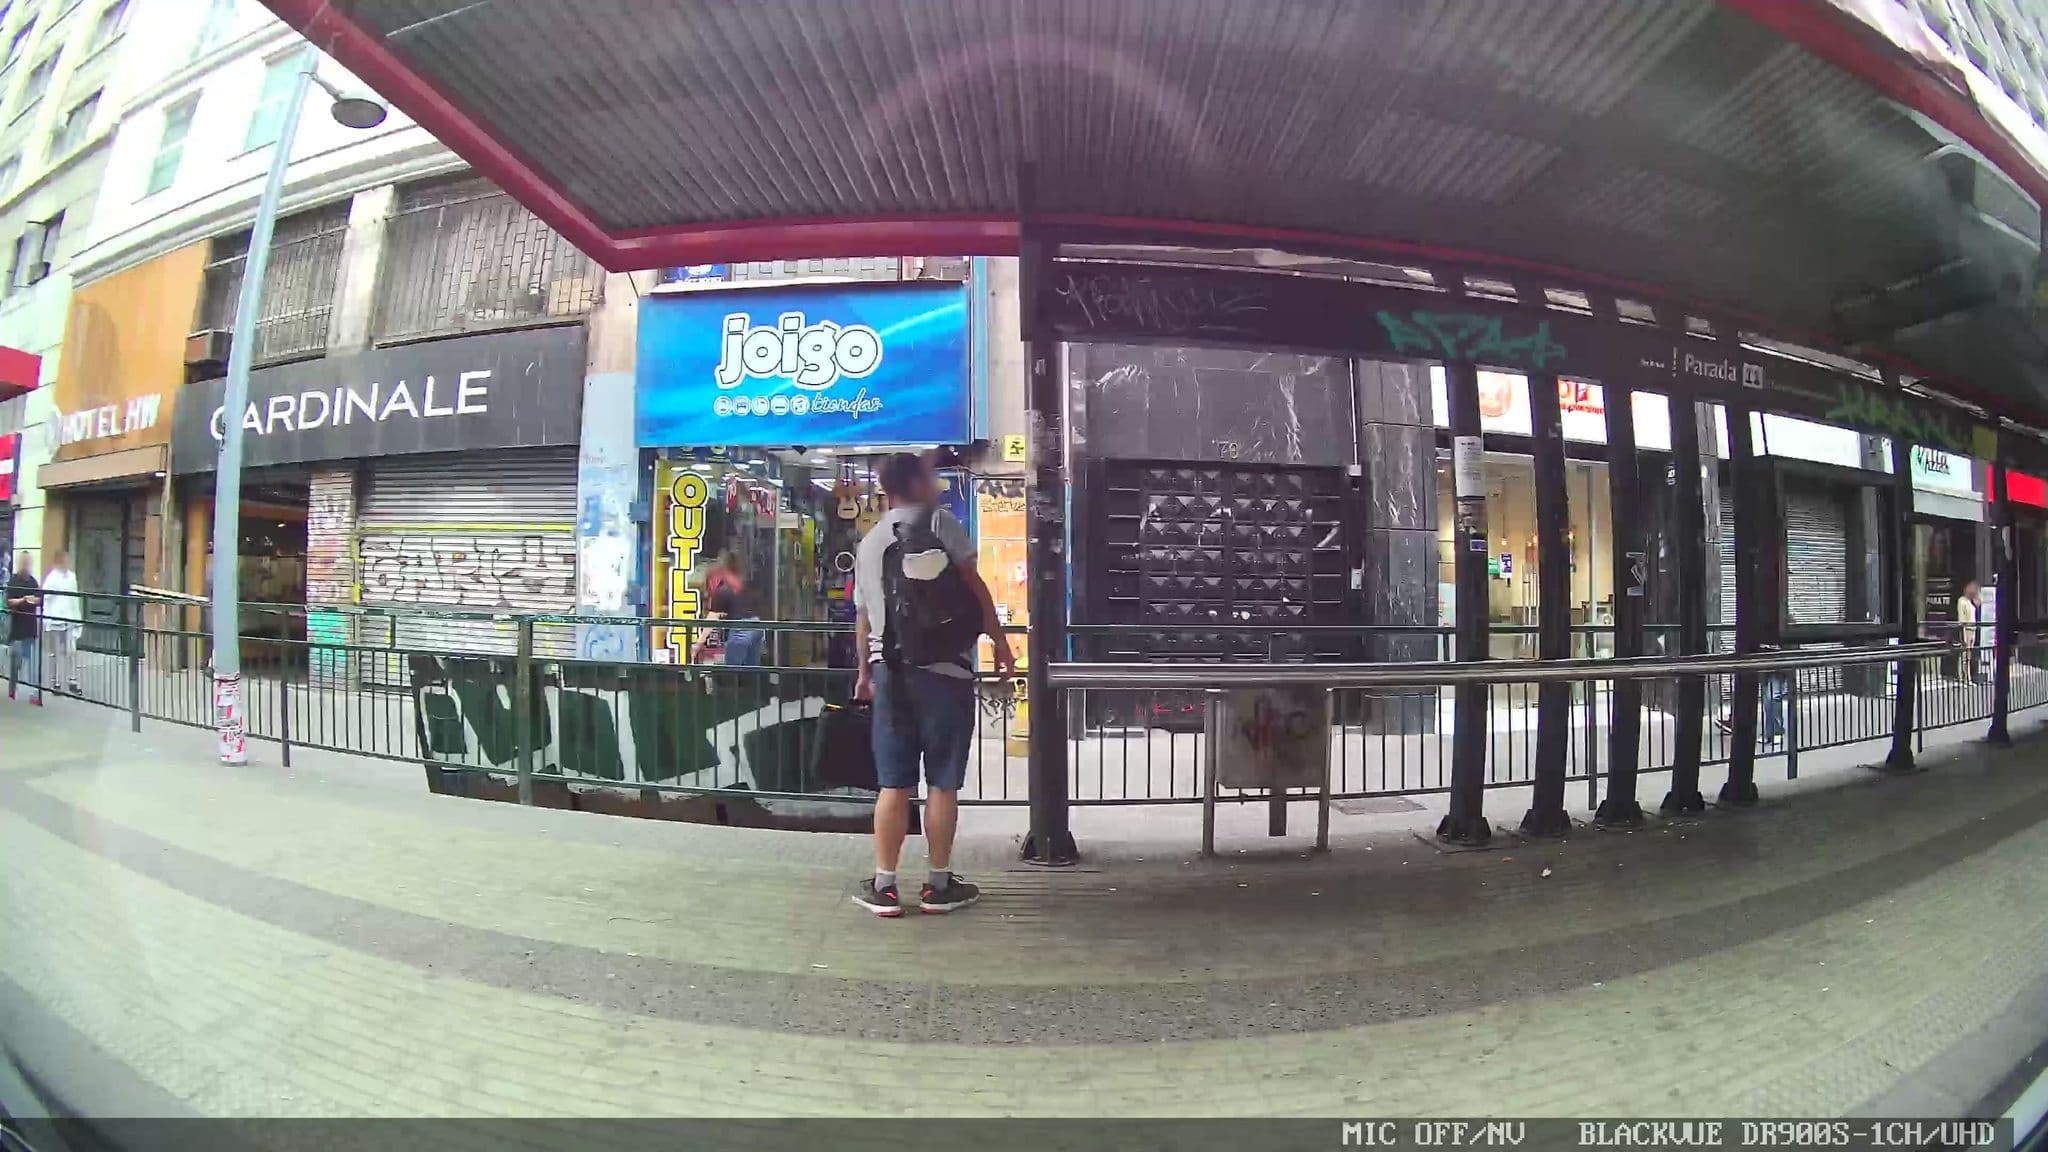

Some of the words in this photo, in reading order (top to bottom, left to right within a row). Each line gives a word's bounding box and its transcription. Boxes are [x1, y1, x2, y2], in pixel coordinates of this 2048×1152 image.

[715, 311, 884, 390] joigo
[1684, 352, 1737, 382] Parada
[812, 388, 883, 419] tiendas
[60, 404, 122, 446] HOTEL
[668, 471, 709, 665] OUTLET
